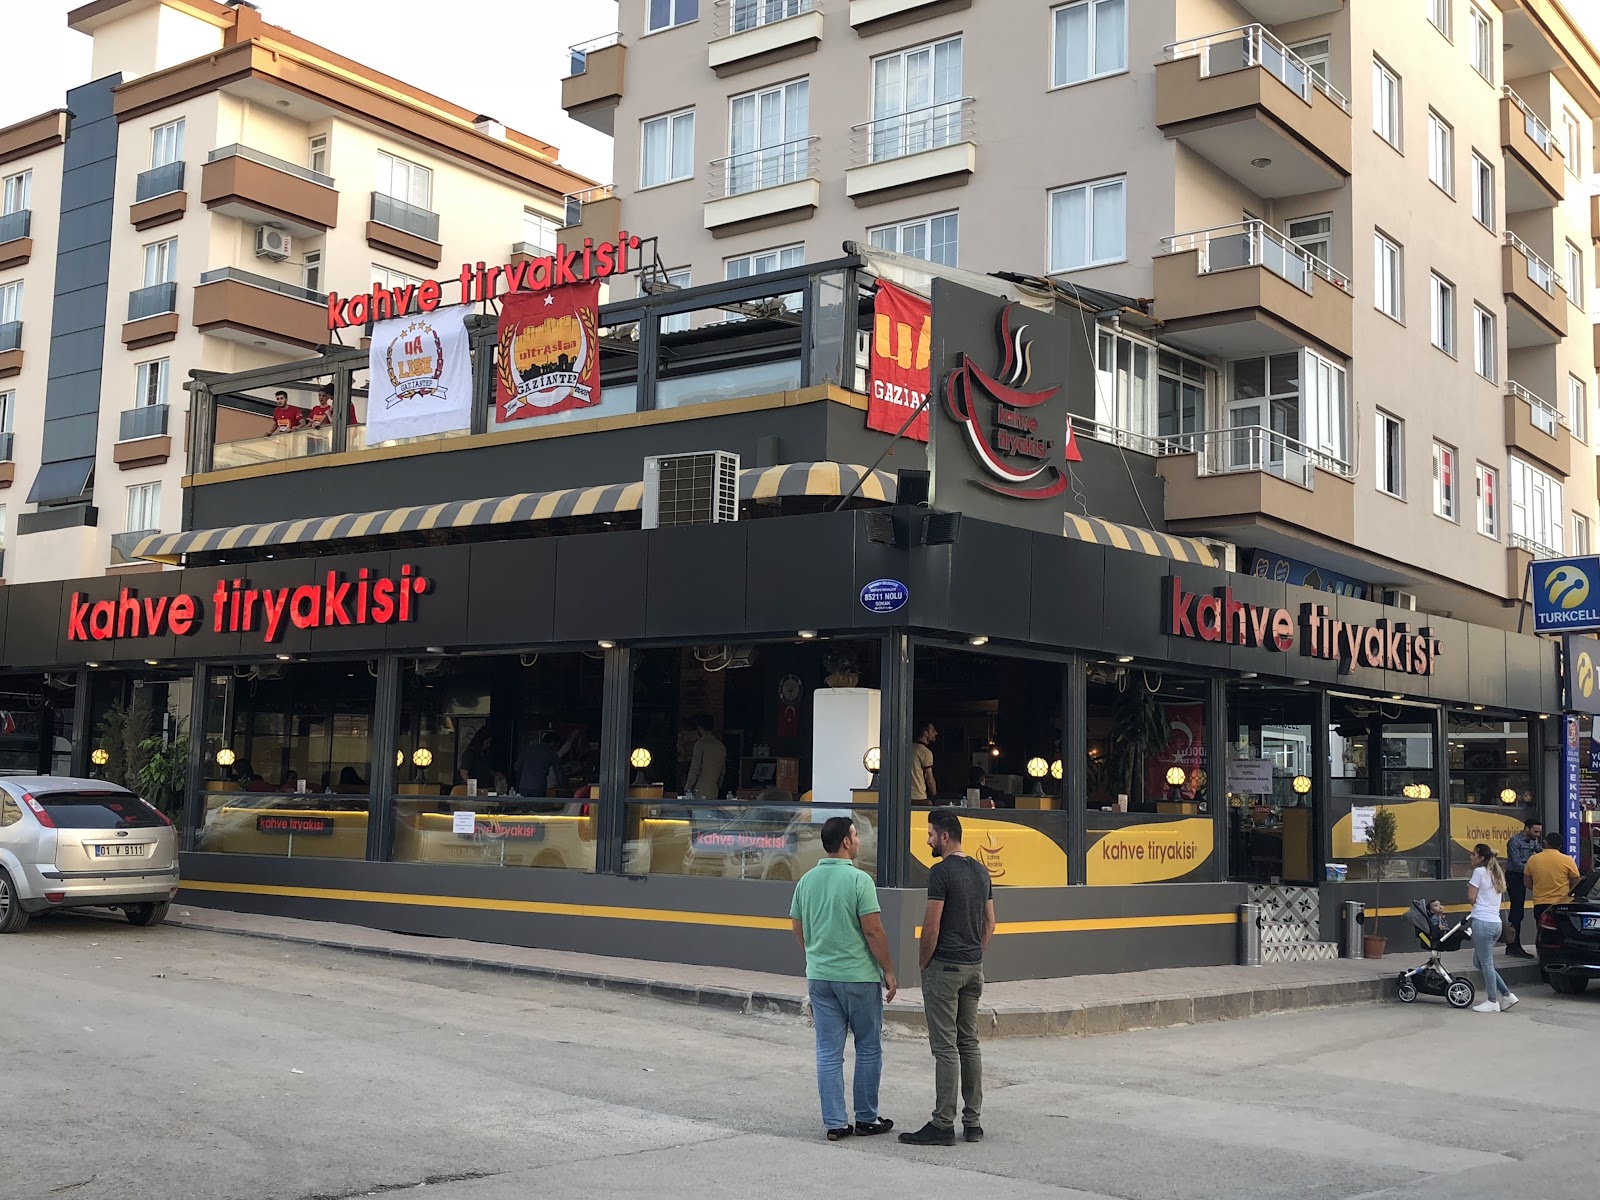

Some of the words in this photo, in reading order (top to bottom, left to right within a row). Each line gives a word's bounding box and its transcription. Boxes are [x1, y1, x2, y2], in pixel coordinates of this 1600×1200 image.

[328, 281, 441, 330] kahve
[460, 231, 631, 304] tiryakisi
[997, 403, 1038, 433] kahve
[997, 428, 1048, 459] tiryakisi
[67, 587, 196, 641] kahve
[213, 564, 416, 643] tiryakisi
[1171, 576, 1294, 652] kahve
[1308, 603, 1435, 675] tiryakisi
[1538, 609, 1600, 624] TURKCELL
[260, 817, 288, 829] kahve
[1466, 825, 1490, 840] kahve
[101, 846, 110, 855] 01
[125, 846, 142, 855] 9111
[697, 832, 735, 846] kahve
[1102, 840, 1144, 860] kahve
[1148, 840, 1195, 864] tiryakisi
